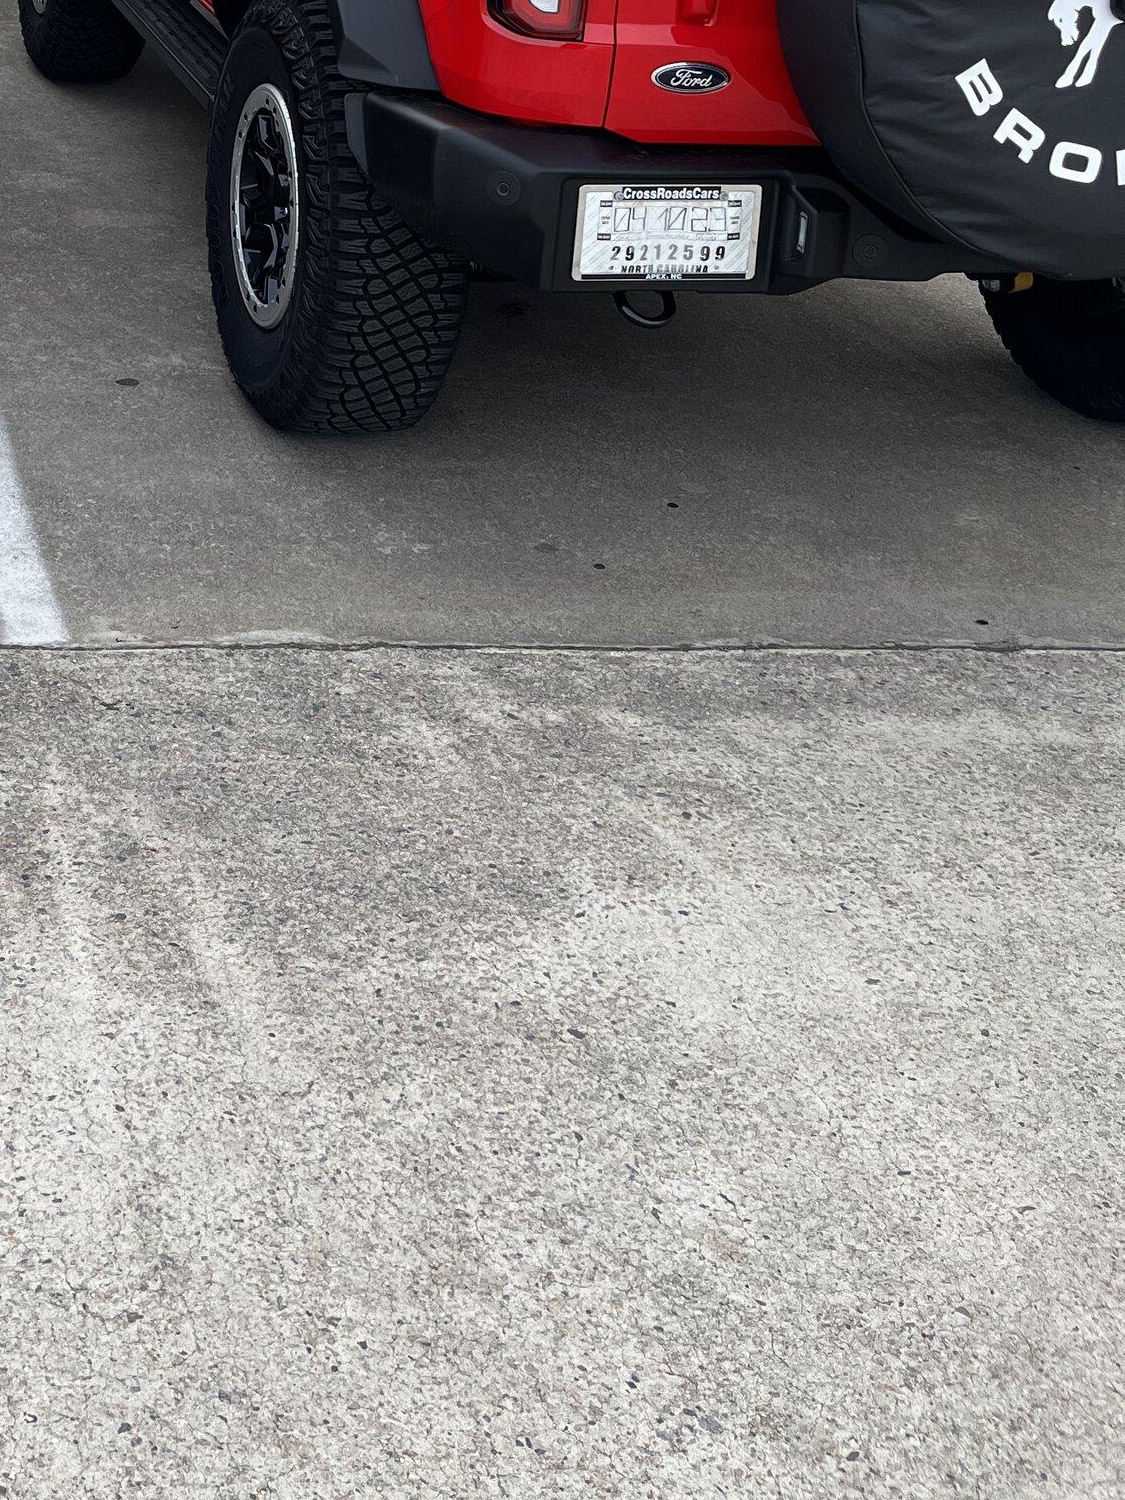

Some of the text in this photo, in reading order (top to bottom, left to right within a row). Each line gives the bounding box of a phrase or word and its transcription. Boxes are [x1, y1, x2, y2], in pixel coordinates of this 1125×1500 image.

[670, 68, 713, 87] Ford
[954, 57, 1125, 187] BRO
[624, 187, 721, 200] CrossRoadsCars
[610, 244, 726, 261] 29212599
[620, 264, 708, 273] NORTH CAROLINA
